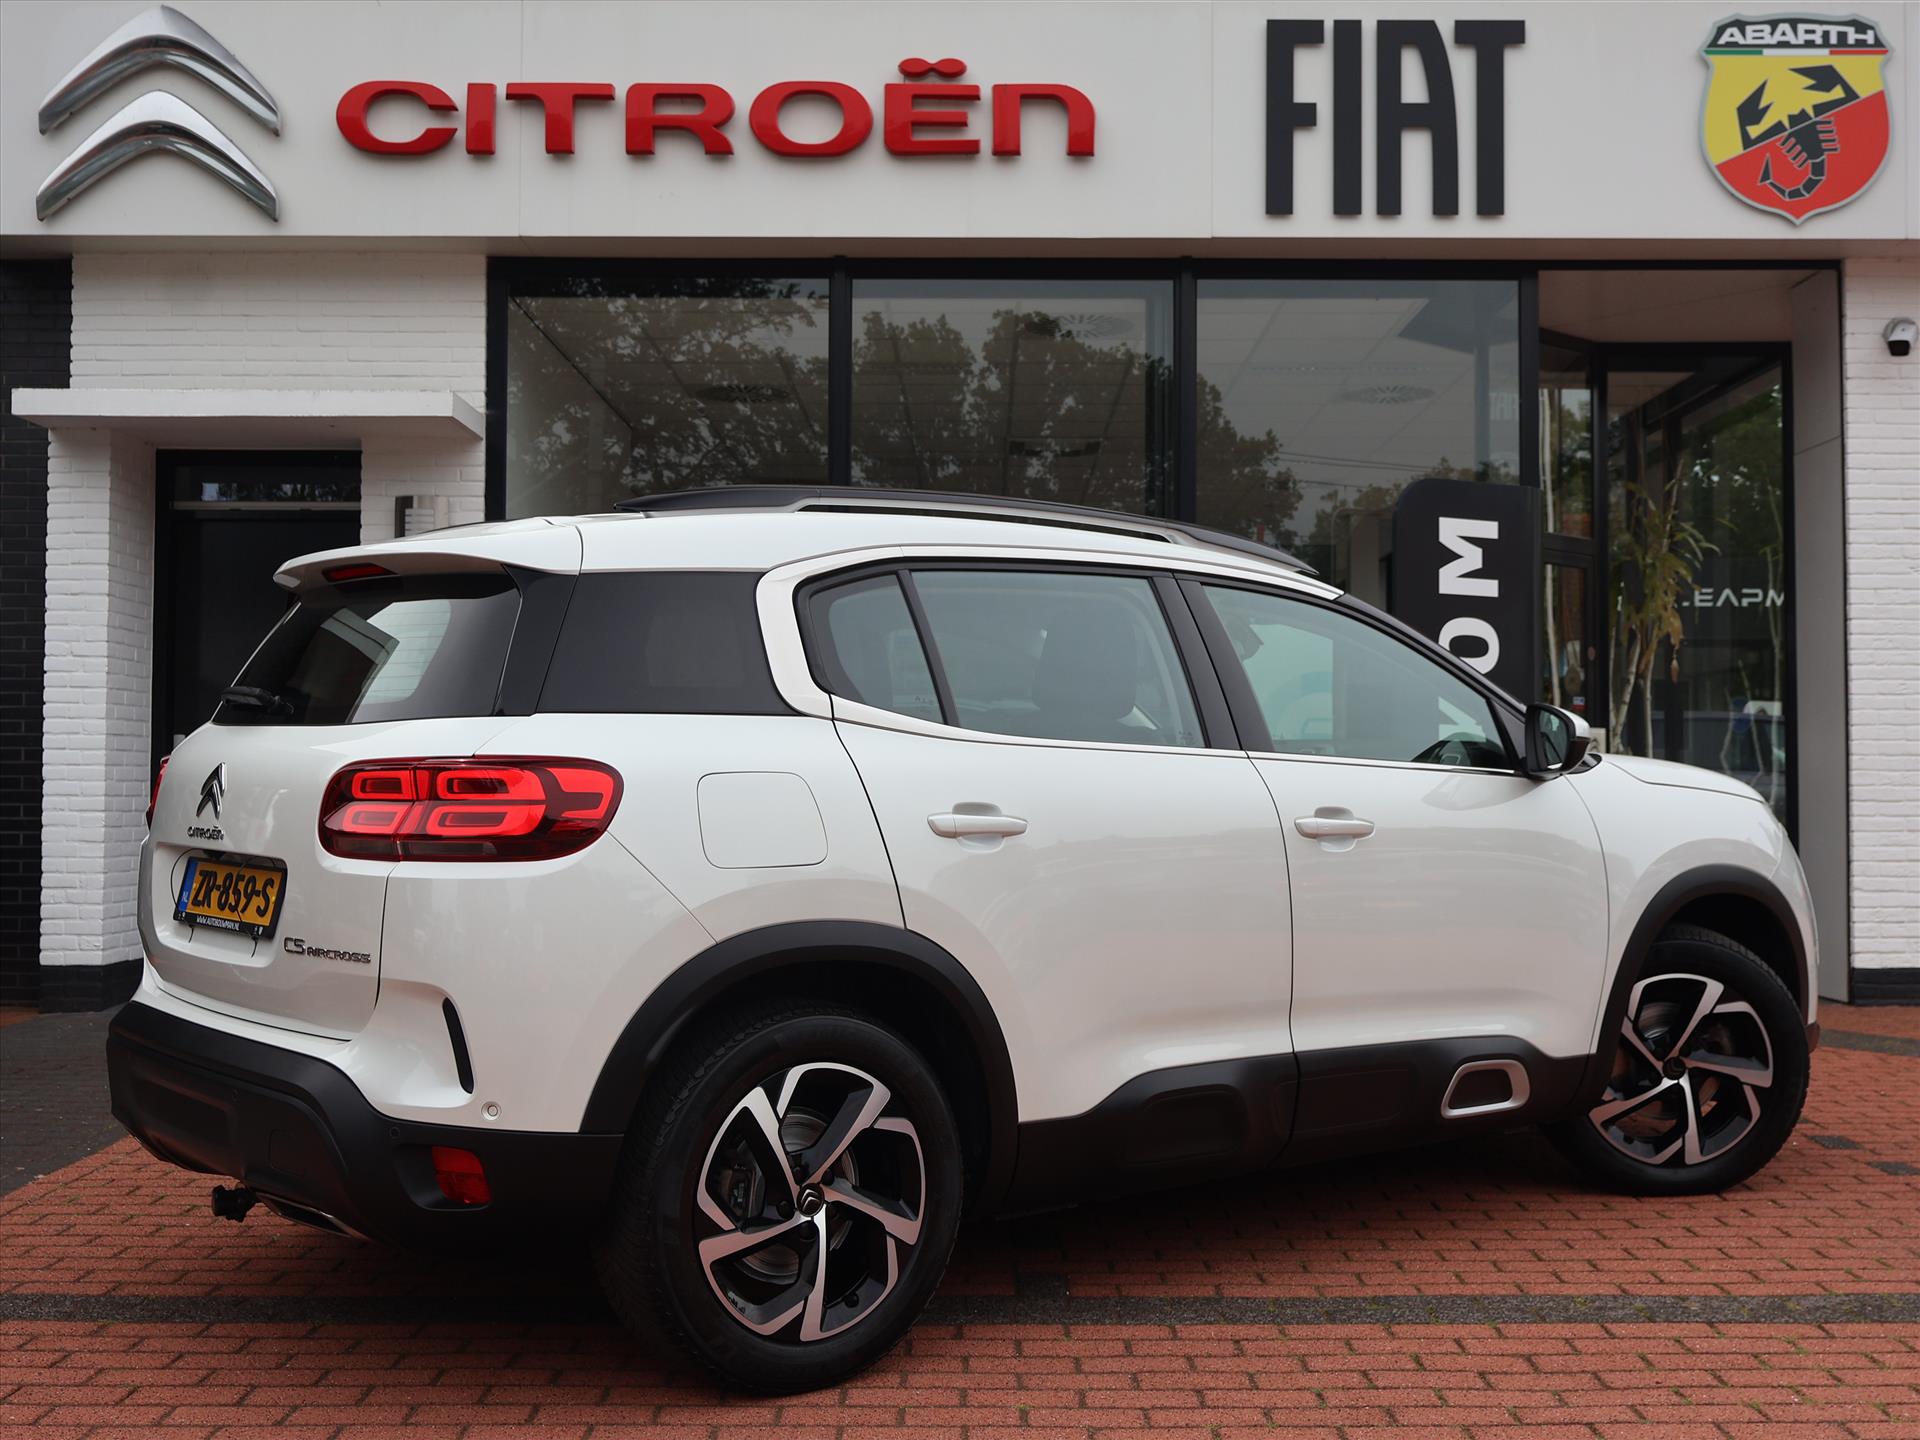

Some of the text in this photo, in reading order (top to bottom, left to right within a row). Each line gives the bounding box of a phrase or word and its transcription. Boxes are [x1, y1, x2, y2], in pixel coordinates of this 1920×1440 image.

[1717, 22, 1876, 46] ABARTH
[336, 57, 1096, 158] CITROËN
[1265, 19, 1526, 216] FIAT
[191, 869, 275, 918] ZR-859-S
[284, 937, 371, 963] C5 AIRCROSS
